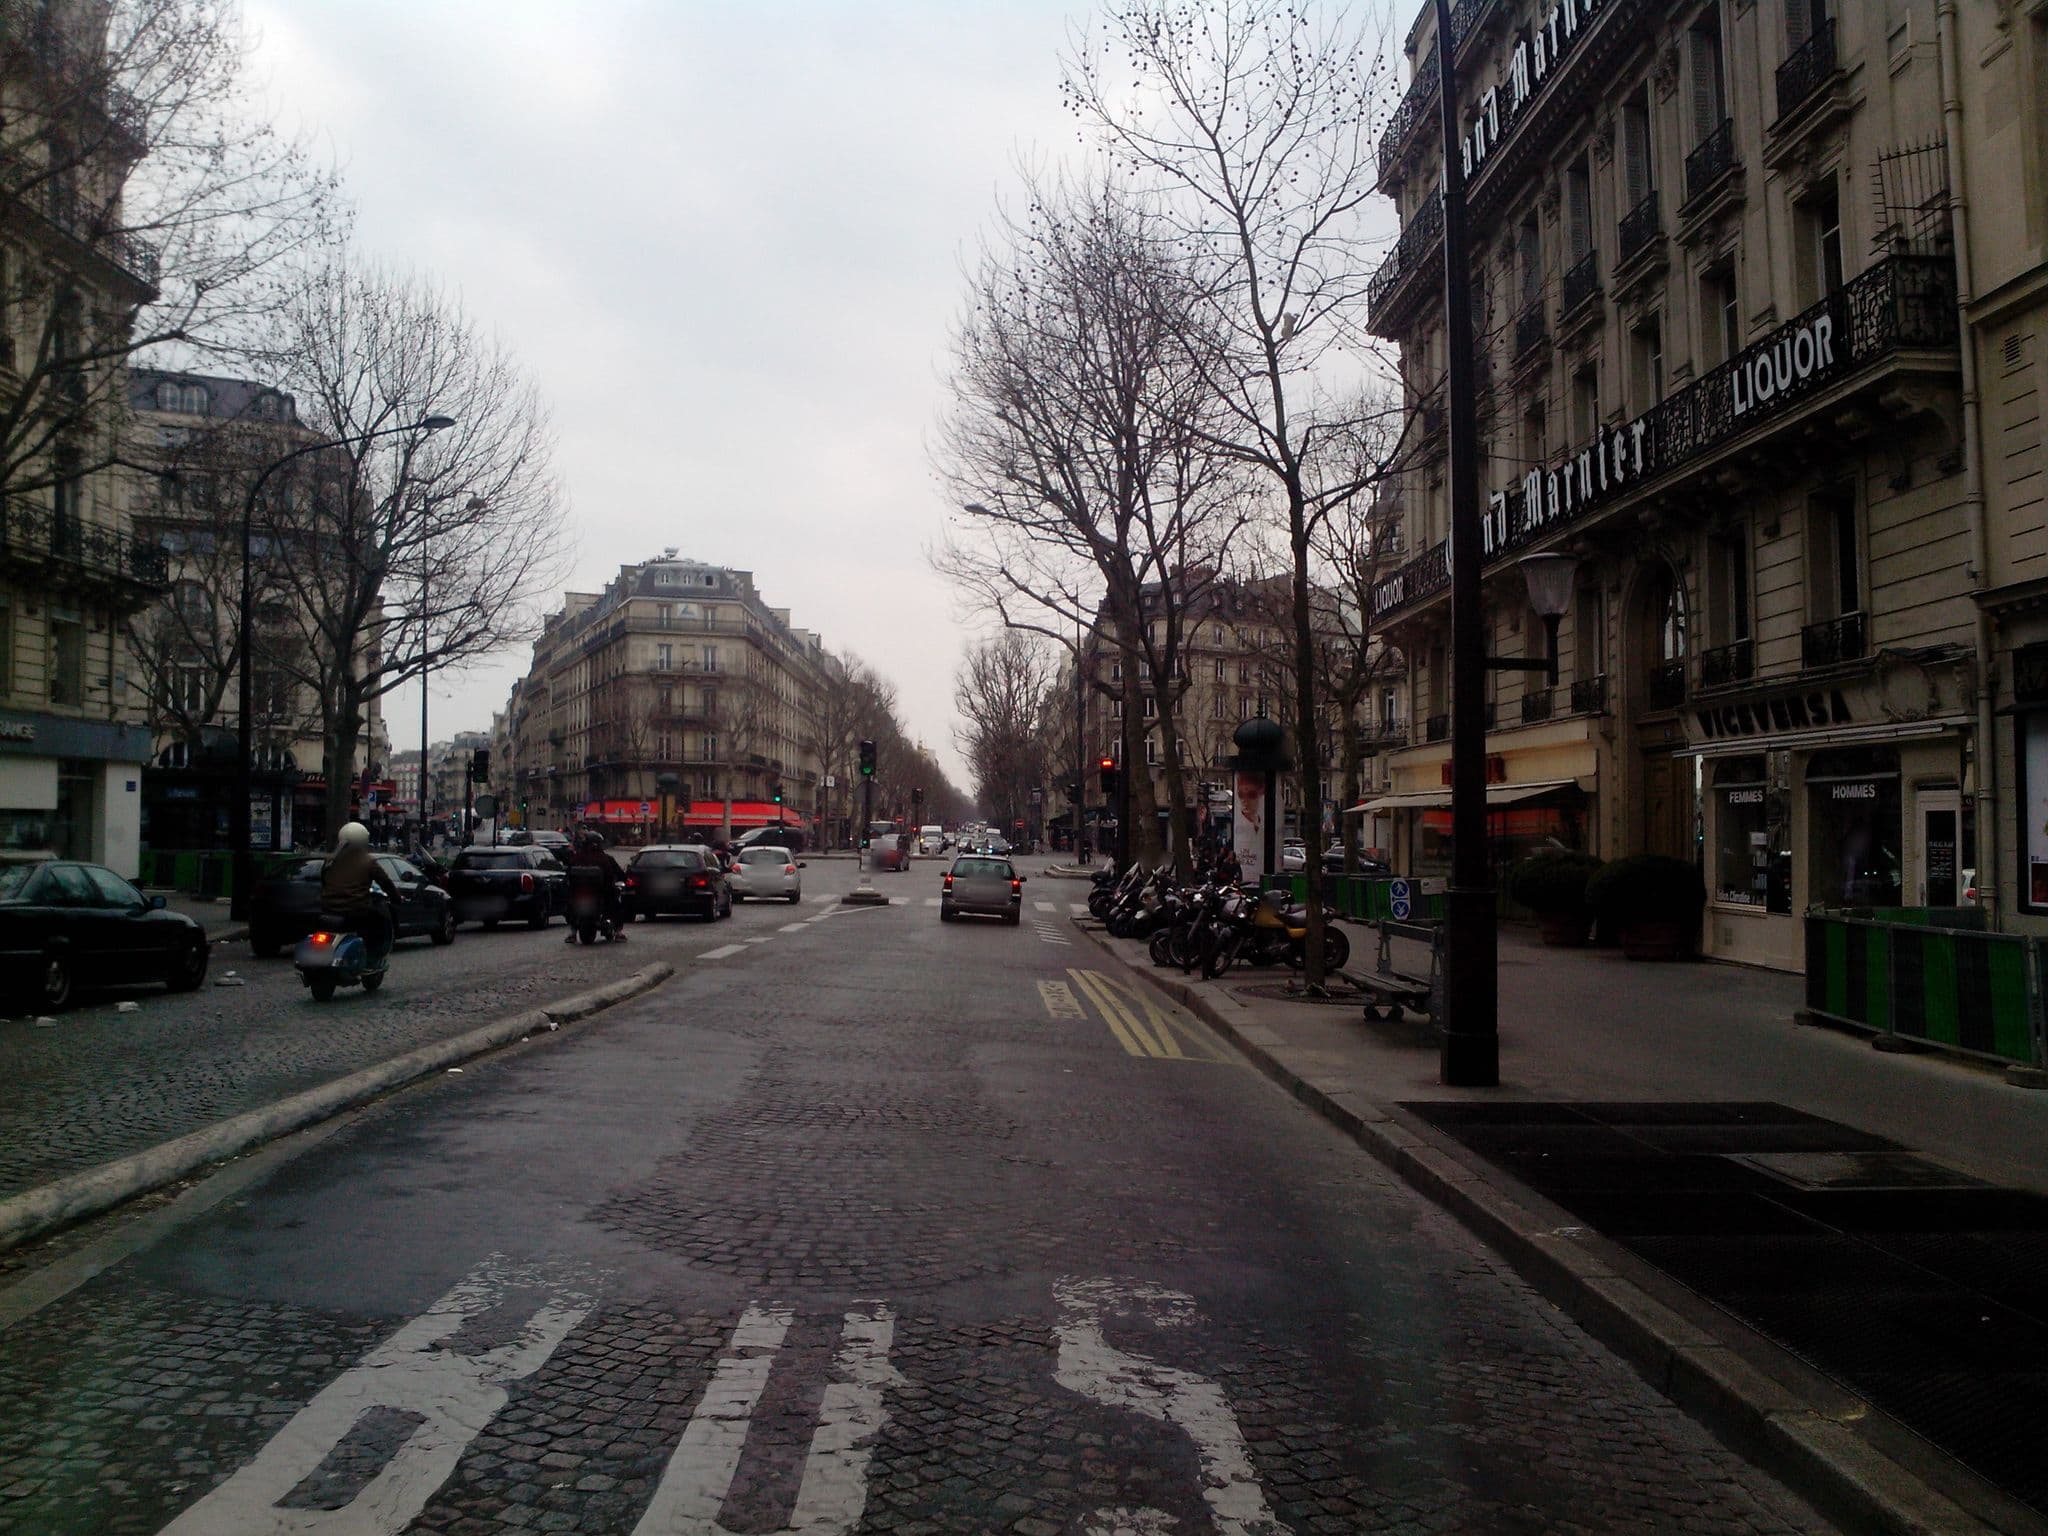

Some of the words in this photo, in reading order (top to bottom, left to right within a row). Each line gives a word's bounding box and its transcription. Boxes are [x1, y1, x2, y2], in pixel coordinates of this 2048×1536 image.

[1733, 314, 1834, 417] LIQUOR
[1522, 417, 1646, 532] Marnier
[1375, 576, 1404, 614] LIQUOR
[1728, 789, 1764, 805] FEMMES
[1831, 783, 1876, 800] HOMMES
